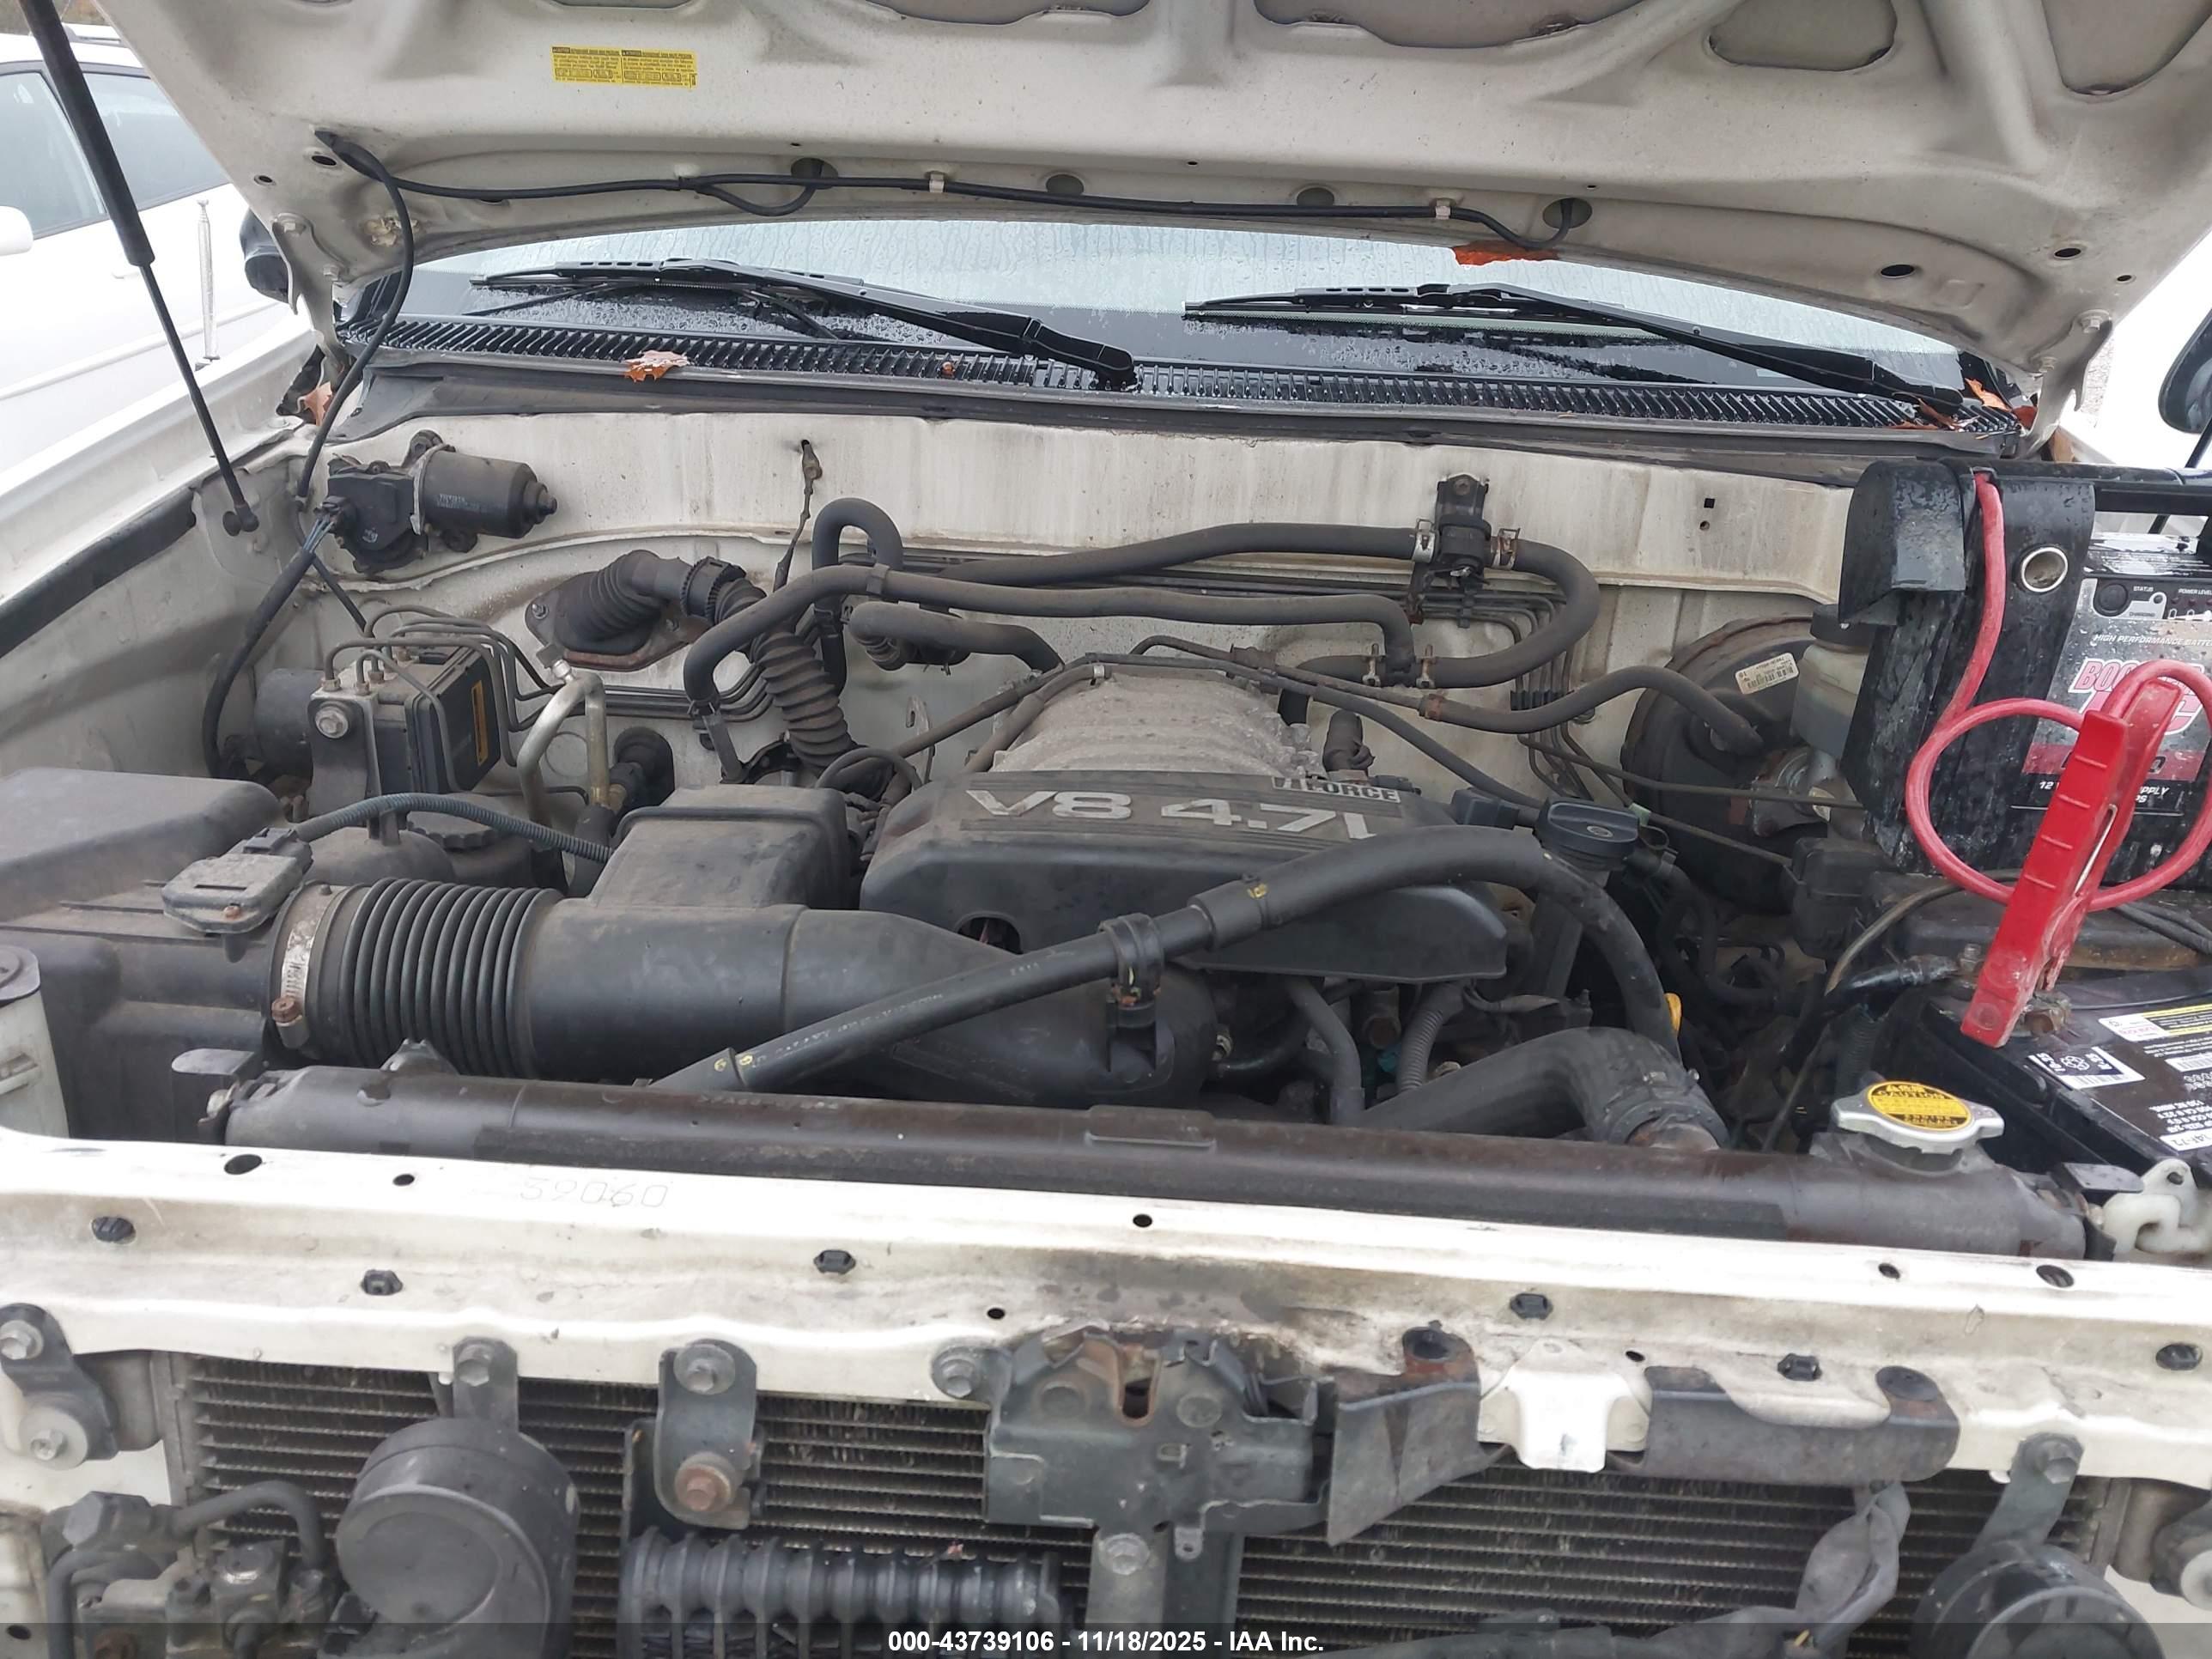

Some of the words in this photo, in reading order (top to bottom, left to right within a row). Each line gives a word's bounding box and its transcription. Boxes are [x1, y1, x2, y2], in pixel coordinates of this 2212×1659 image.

[2093, 634, 2117, 642] HIGH
[2117, 635, 2182, 645] PERFORMANCE
[2039, 781, 2054, 790] 12
[966, 789, 1132, 819] V8
